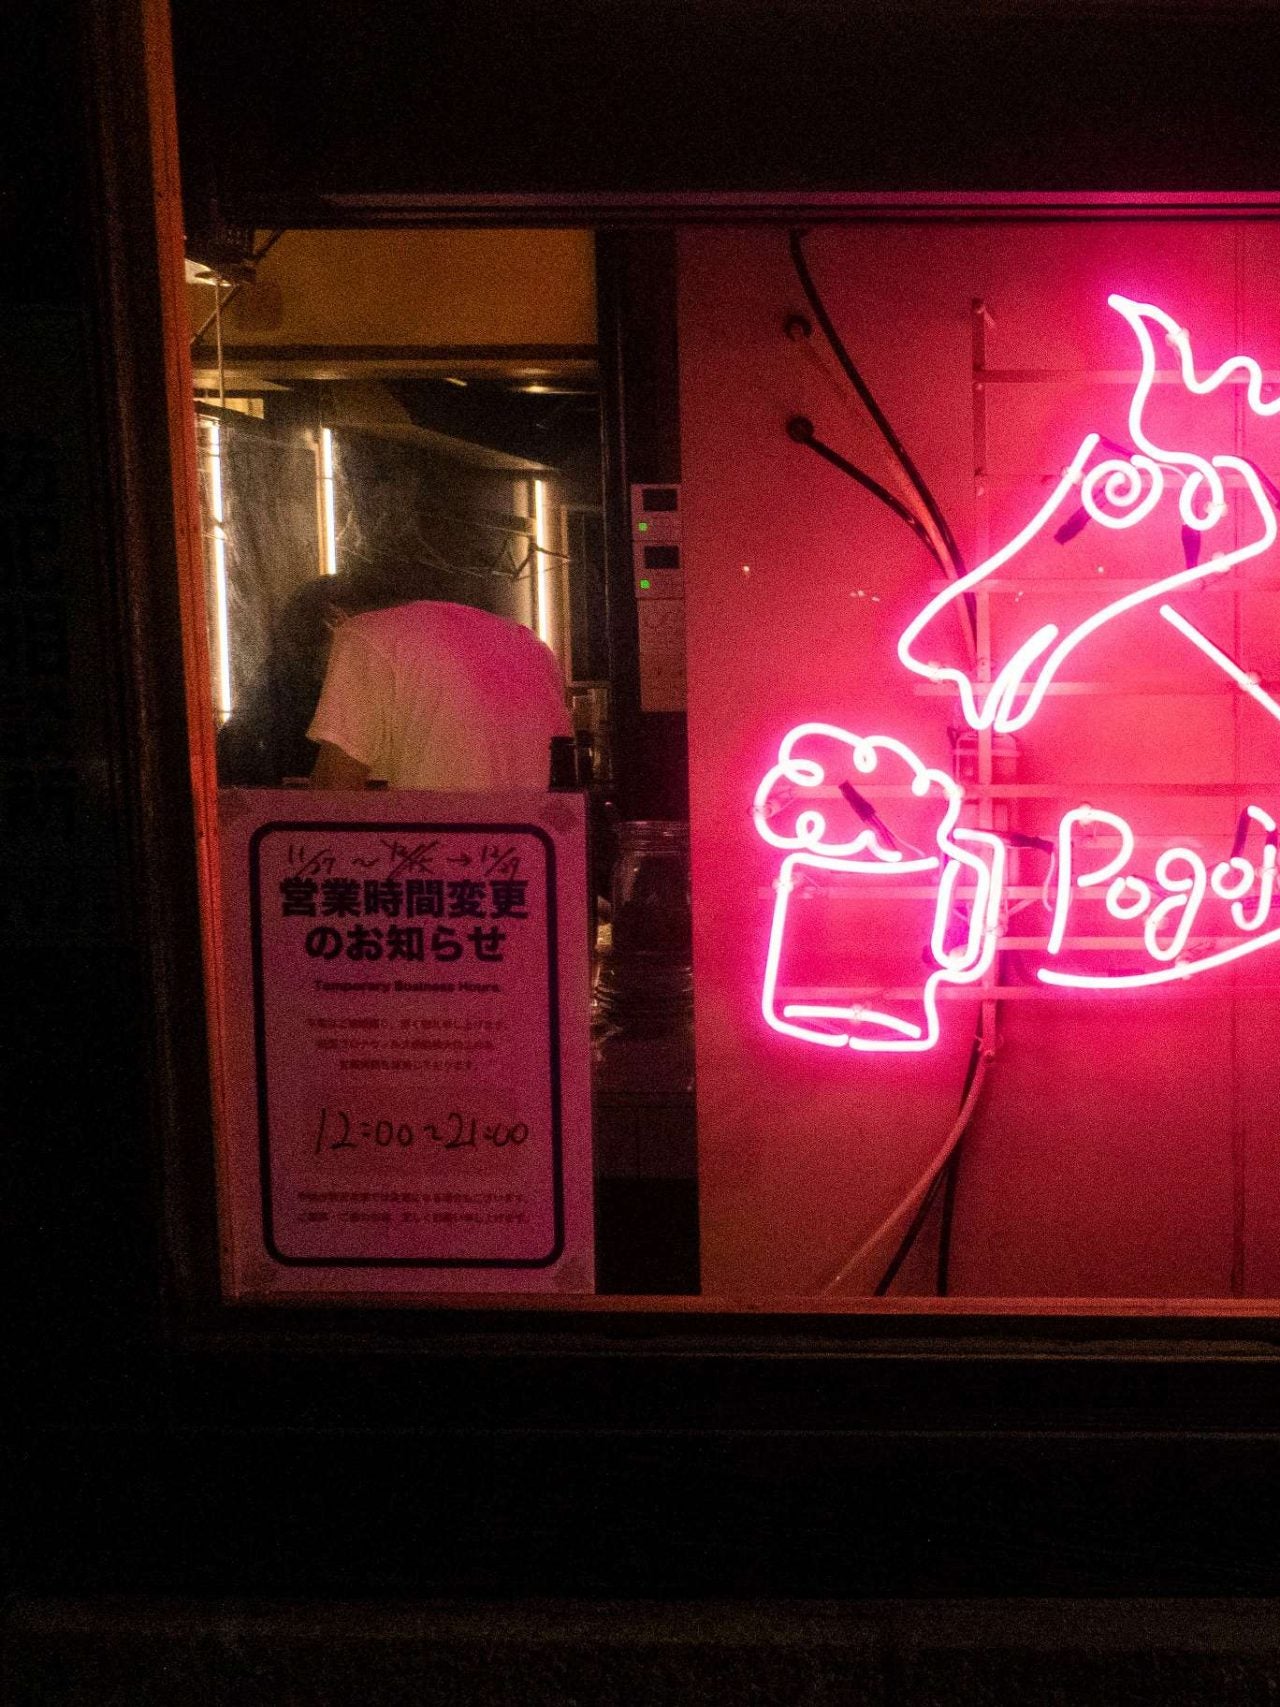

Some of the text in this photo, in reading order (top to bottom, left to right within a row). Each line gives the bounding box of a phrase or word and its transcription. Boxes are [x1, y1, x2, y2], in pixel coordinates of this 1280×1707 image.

[280, 877, 529, 919] 営業時間変更
[305, 923, 507, 963] のお知らせ
[314, 979, 391, 994] Temporary
[394, 979, 455, 993] Business
